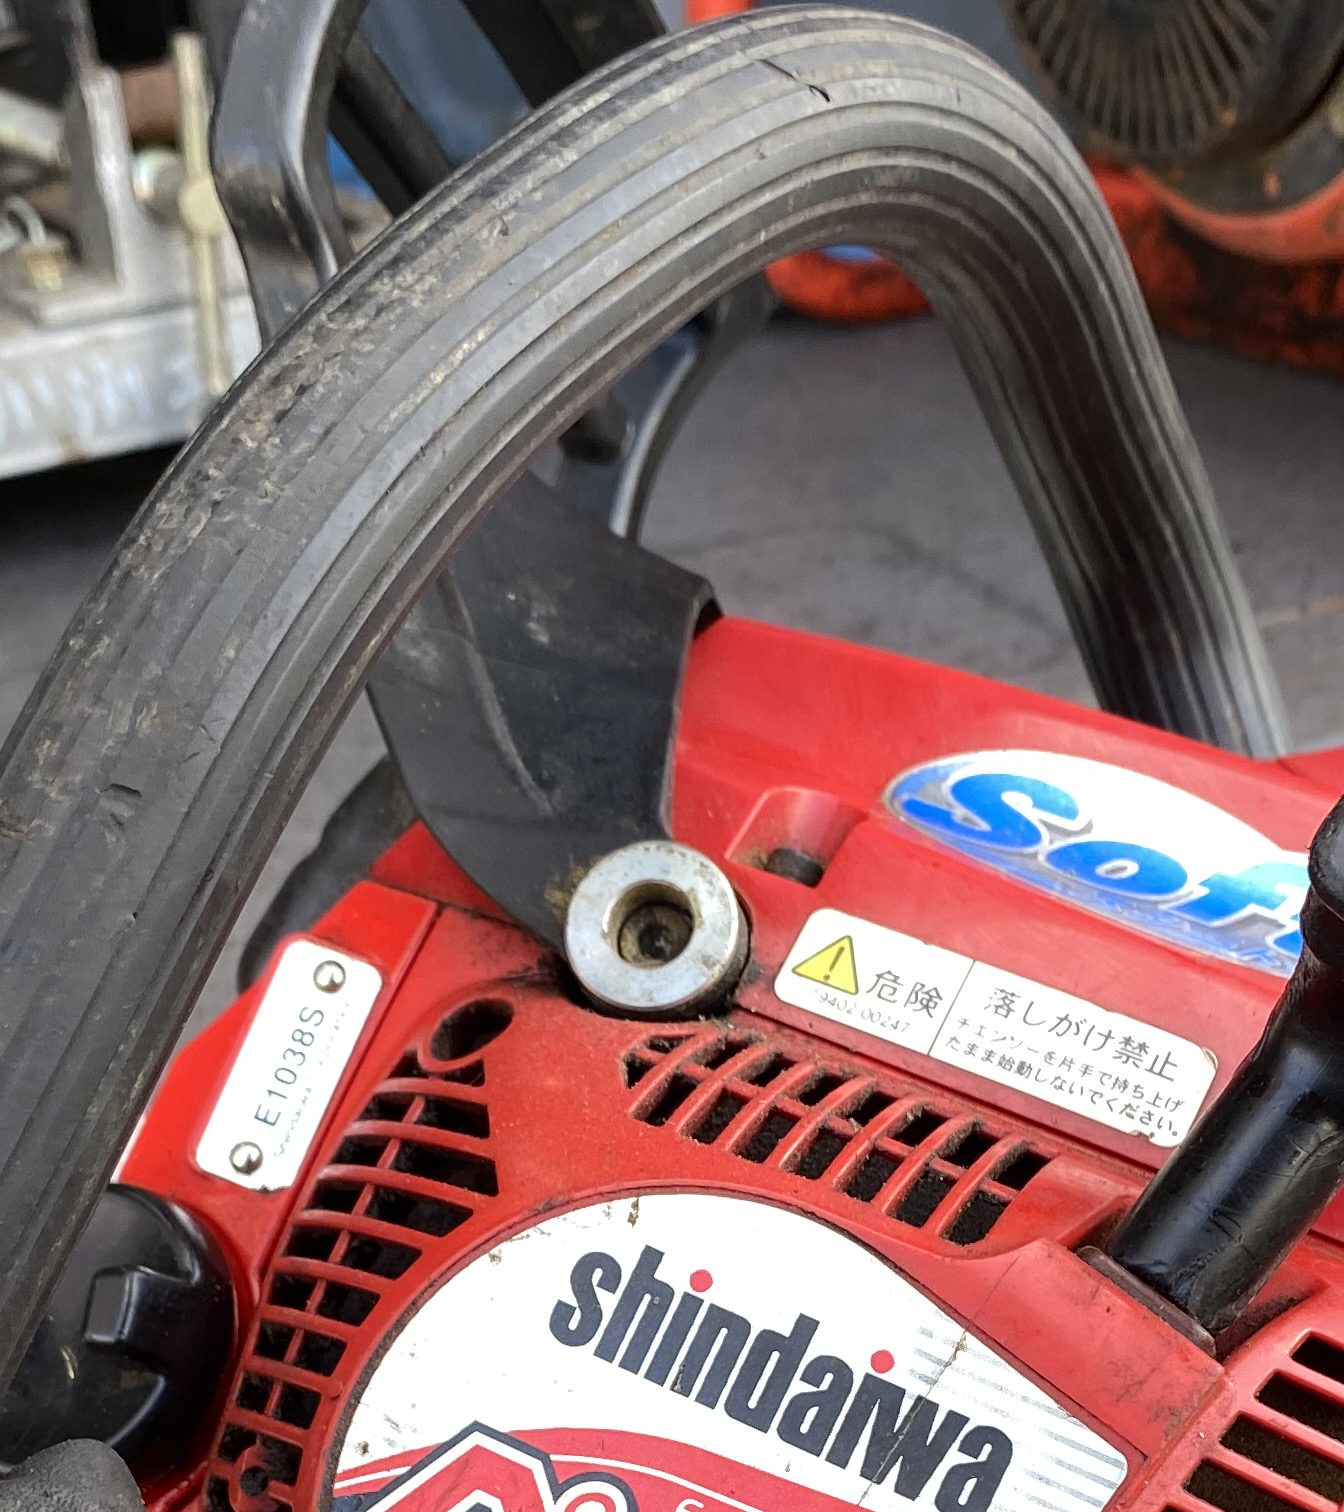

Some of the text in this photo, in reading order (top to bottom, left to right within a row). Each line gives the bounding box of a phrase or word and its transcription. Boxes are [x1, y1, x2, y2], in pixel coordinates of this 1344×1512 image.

[896, 770, 1311, 958] Sof
[866, 970, 943, 1019] 危険
[984, 987, 1178, 1082] 落しがけ禁止
[253, 1006, 325, 1127] E1038S
